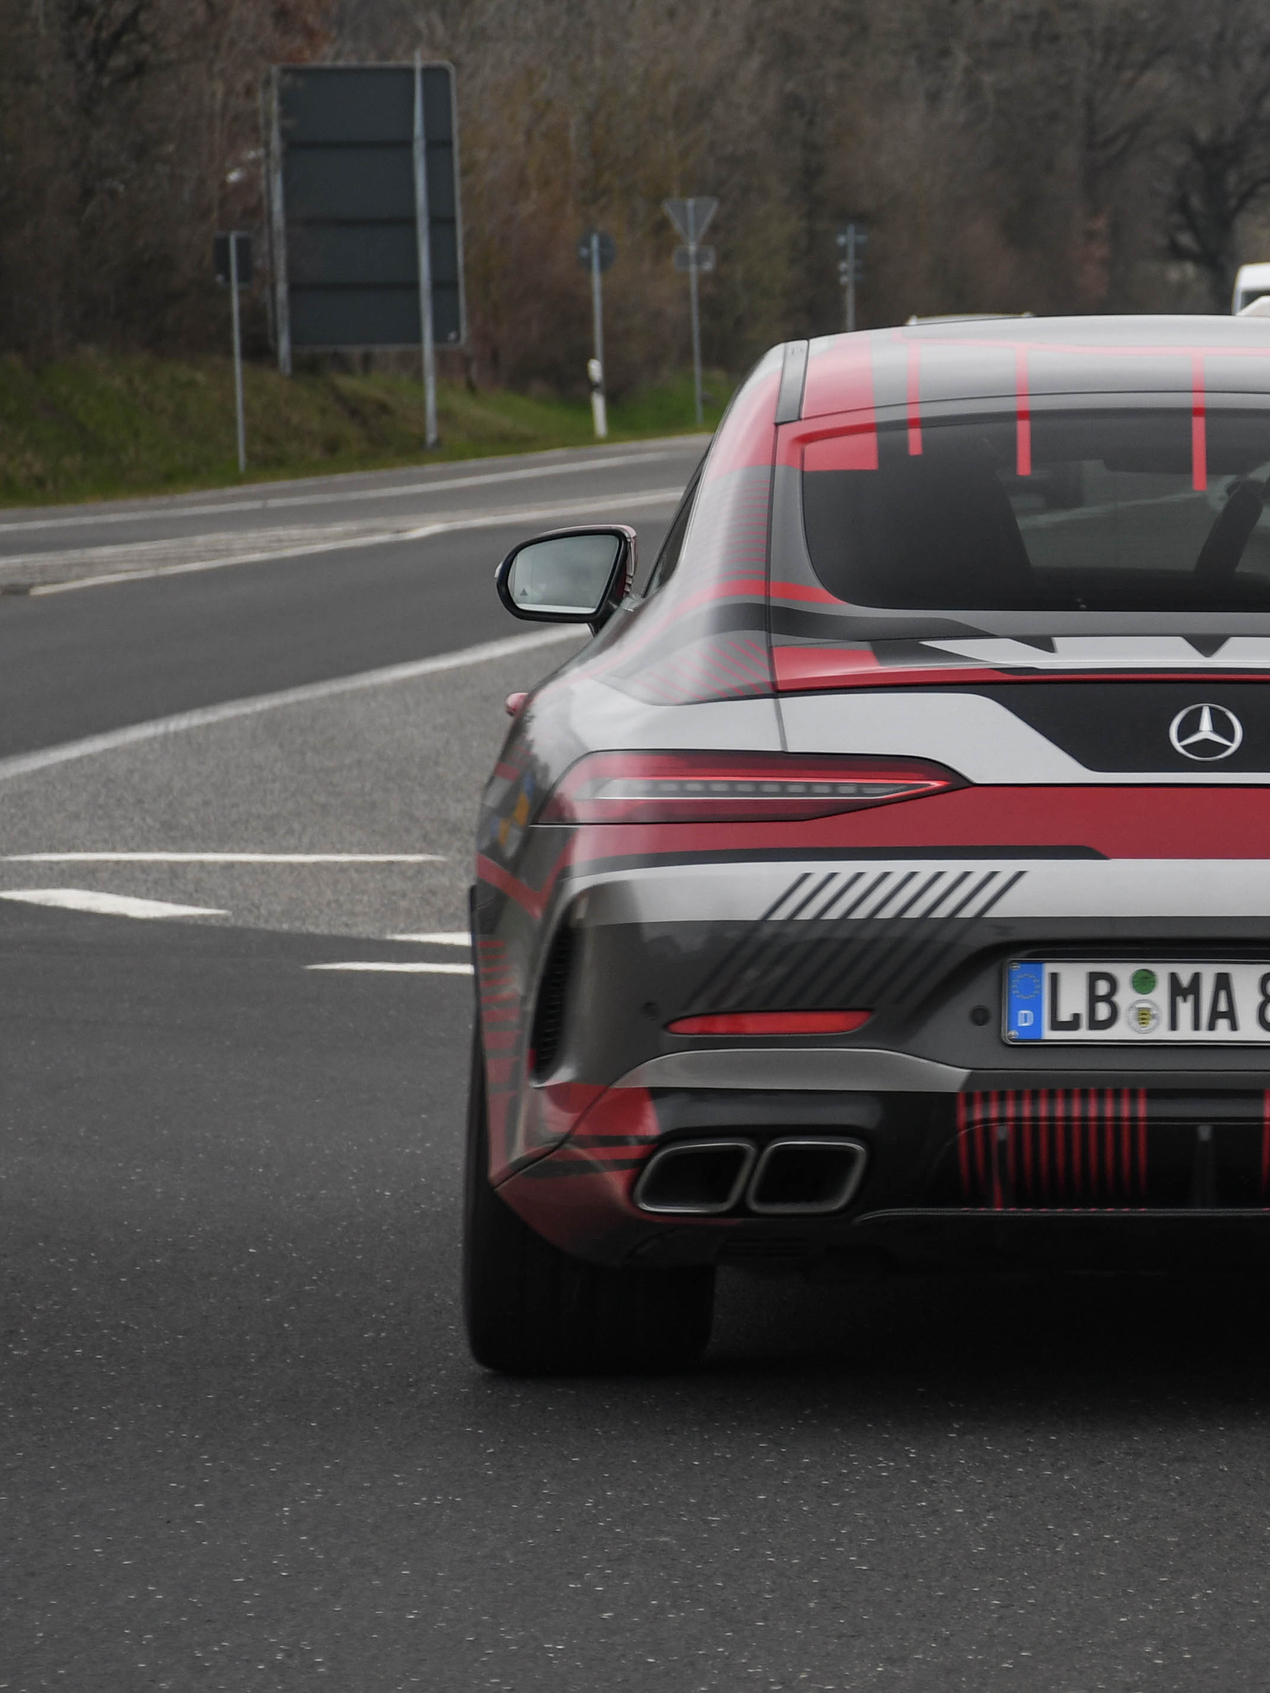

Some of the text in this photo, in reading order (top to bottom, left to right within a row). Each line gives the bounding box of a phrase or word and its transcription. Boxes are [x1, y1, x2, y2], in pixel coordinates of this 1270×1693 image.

[1018, 1010, 1034, 1027] D
[1048, 972, 1119, 1032] LB
[1167, 972, 1239, 1032] MA
